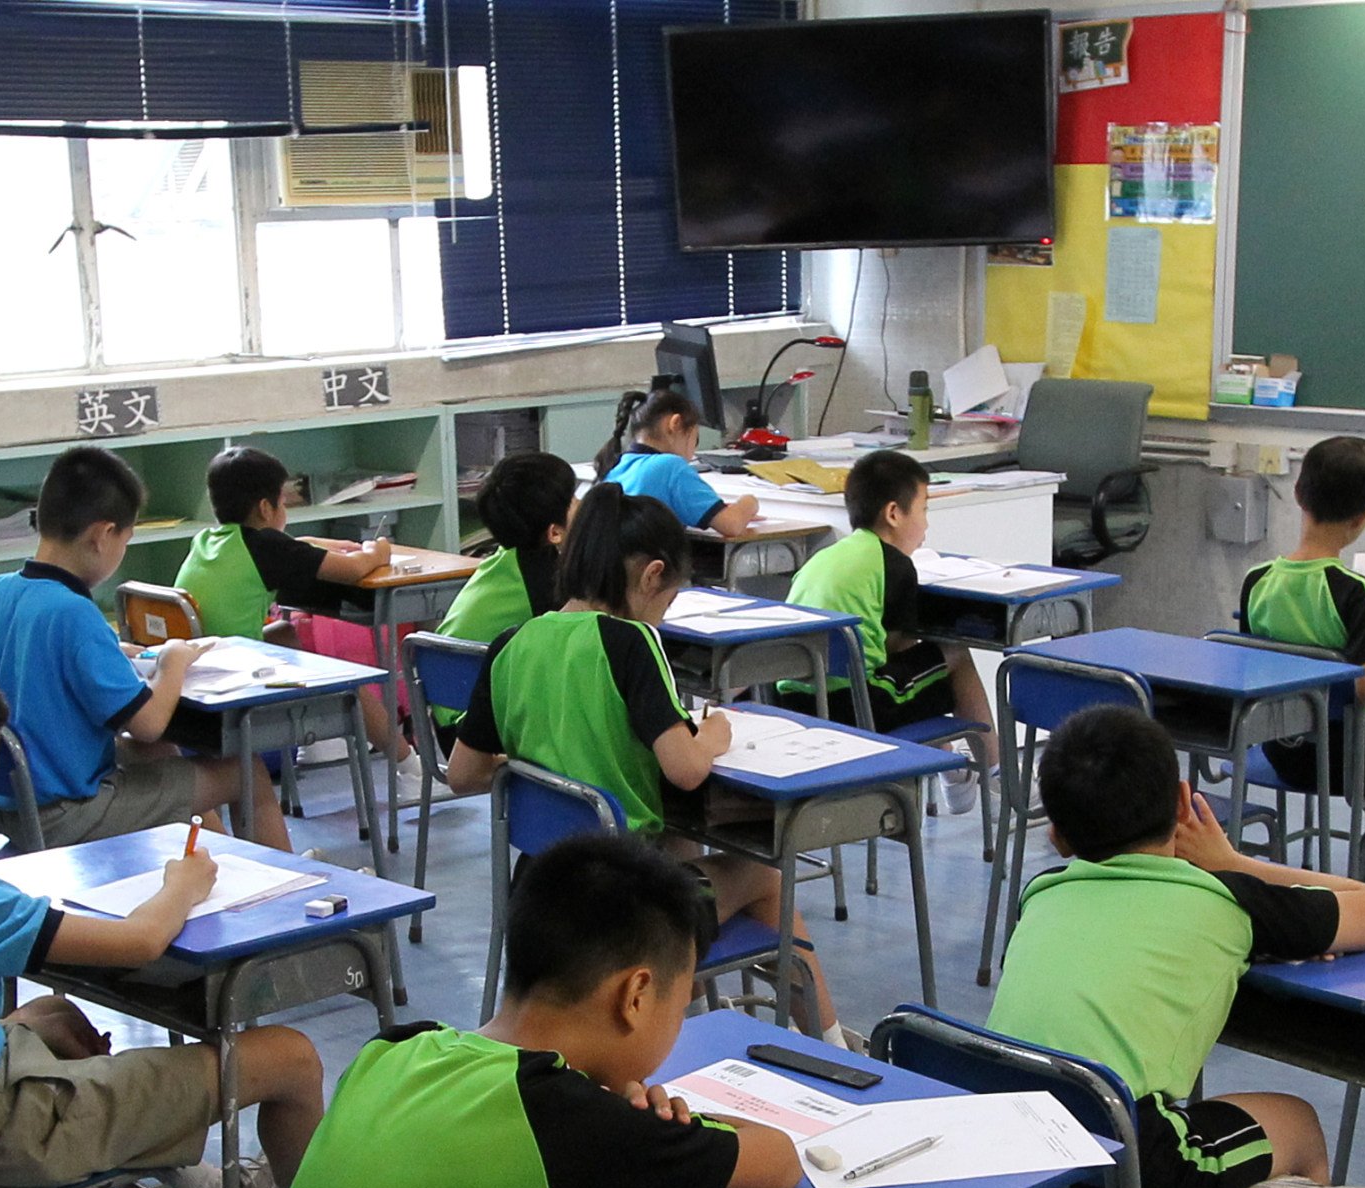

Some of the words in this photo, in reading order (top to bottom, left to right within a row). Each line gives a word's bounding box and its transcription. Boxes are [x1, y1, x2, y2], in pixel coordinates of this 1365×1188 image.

[1069, 26, 1117, 59] 報告
[322, 368, 392, 411] 中文
[78, 389, 159, 434] 英文
